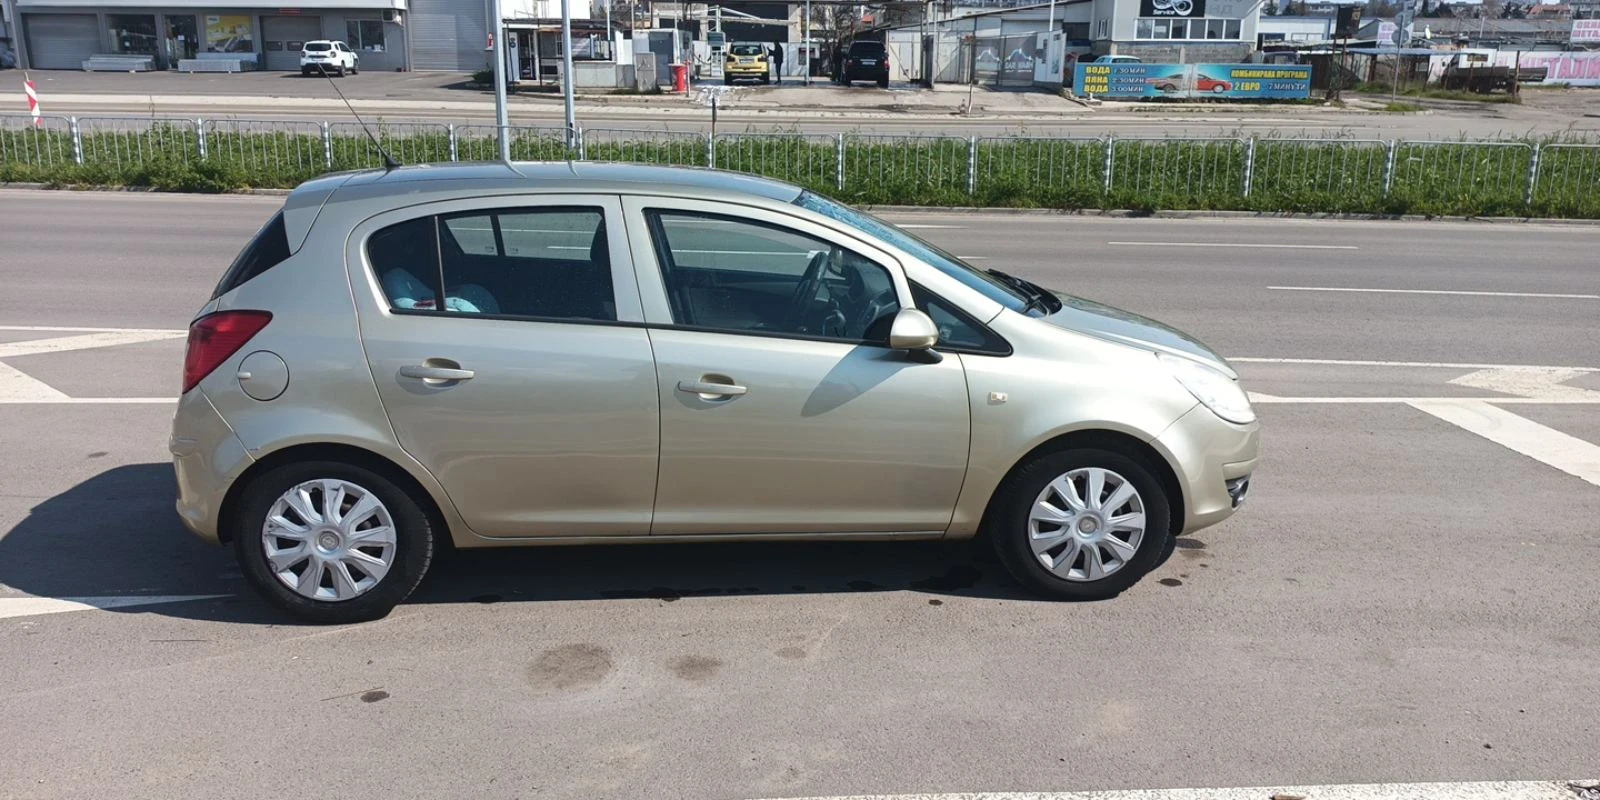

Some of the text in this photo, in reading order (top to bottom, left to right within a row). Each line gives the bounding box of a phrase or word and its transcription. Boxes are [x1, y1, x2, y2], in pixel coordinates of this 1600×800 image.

[1086, 66, 1111, 74] ВОДА
[1085, 76, 1109, 84] ПЯНА
[1234, 82, 1239, 91] 2
[1241, 82, 1260, 91] ЕВРО
